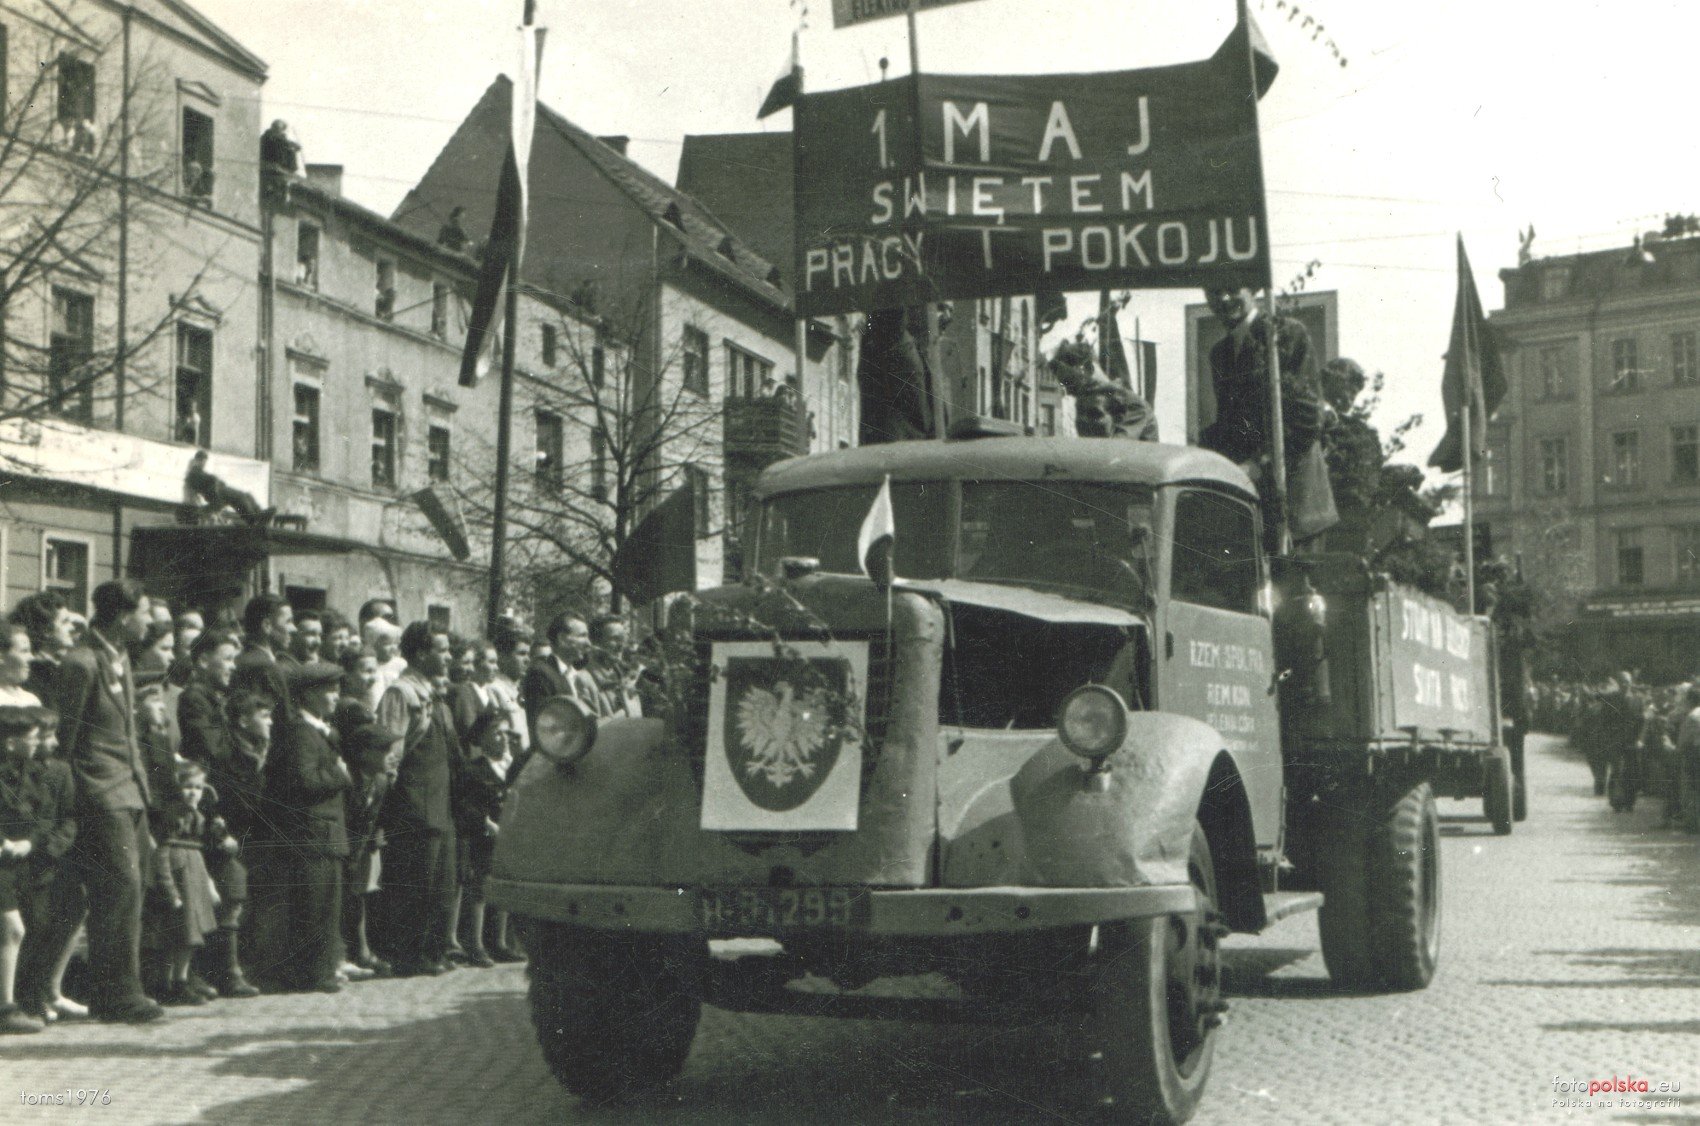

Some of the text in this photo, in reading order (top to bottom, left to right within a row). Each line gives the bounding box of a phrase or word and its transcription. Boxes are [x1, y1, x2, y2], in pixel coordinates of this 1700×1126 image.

[871, 96, 1150, 169] 1. MAJ
[805, 231, 925, 291] PRACY
[1042, 216, 1258, 272] POKOJU
